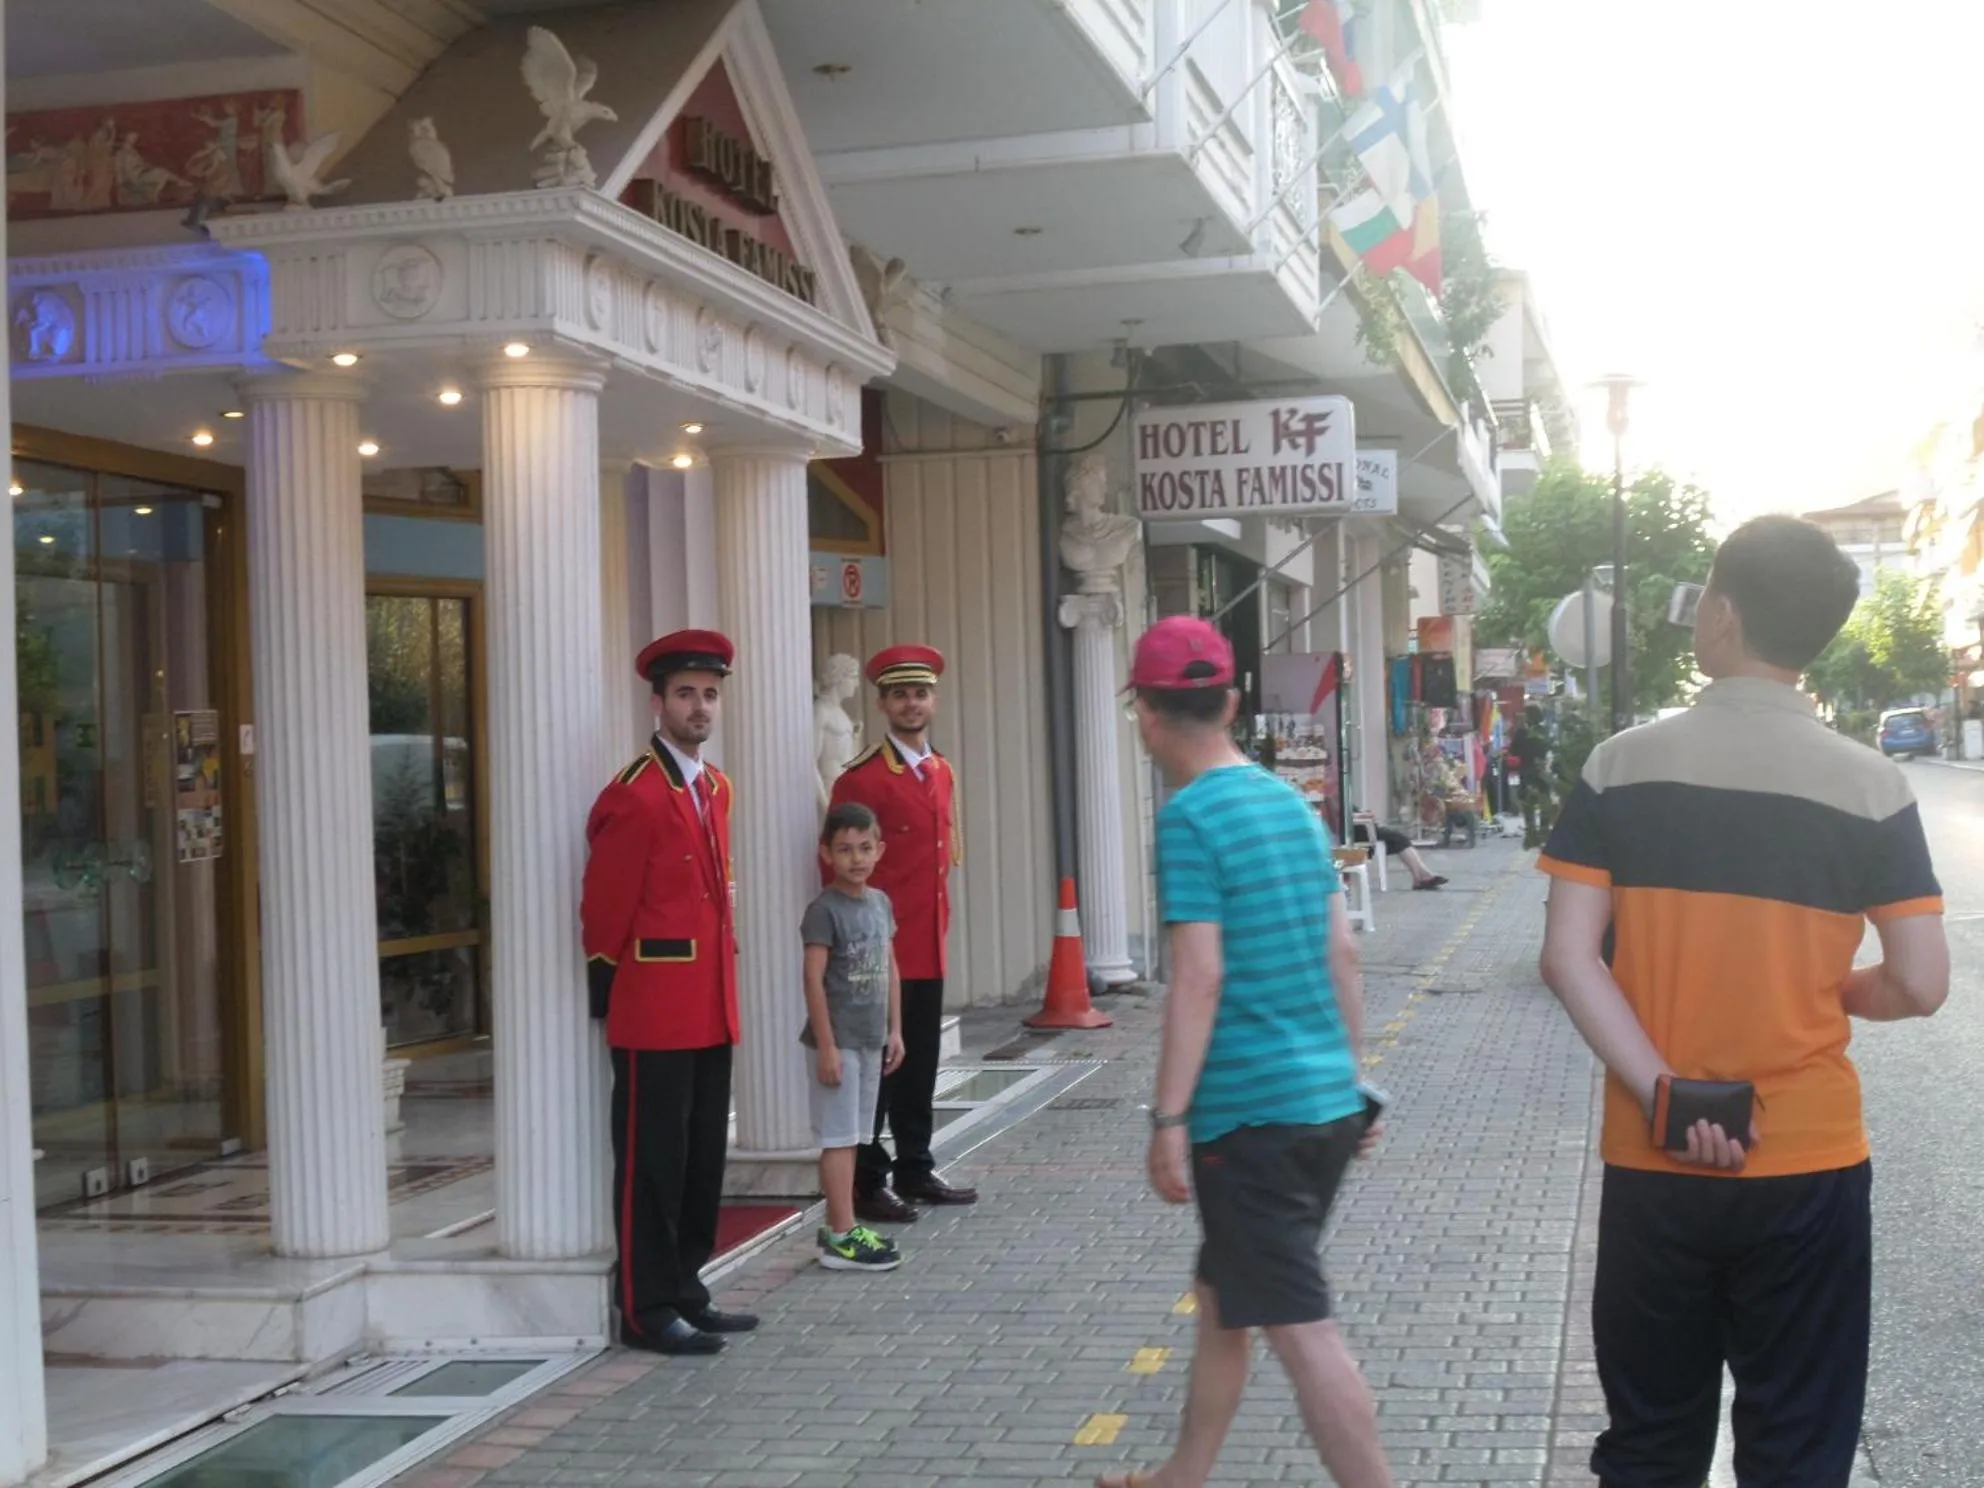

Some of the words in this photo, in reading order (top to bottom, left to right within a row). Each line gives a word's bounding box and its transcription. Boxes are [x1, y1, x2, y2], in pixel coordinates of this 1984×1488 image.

[1138, 418, 1250, 460] HOTEL
[1139, 469, 1229, 512] KOSTA
[1236, 462, 1346, 508] FAMISSI
